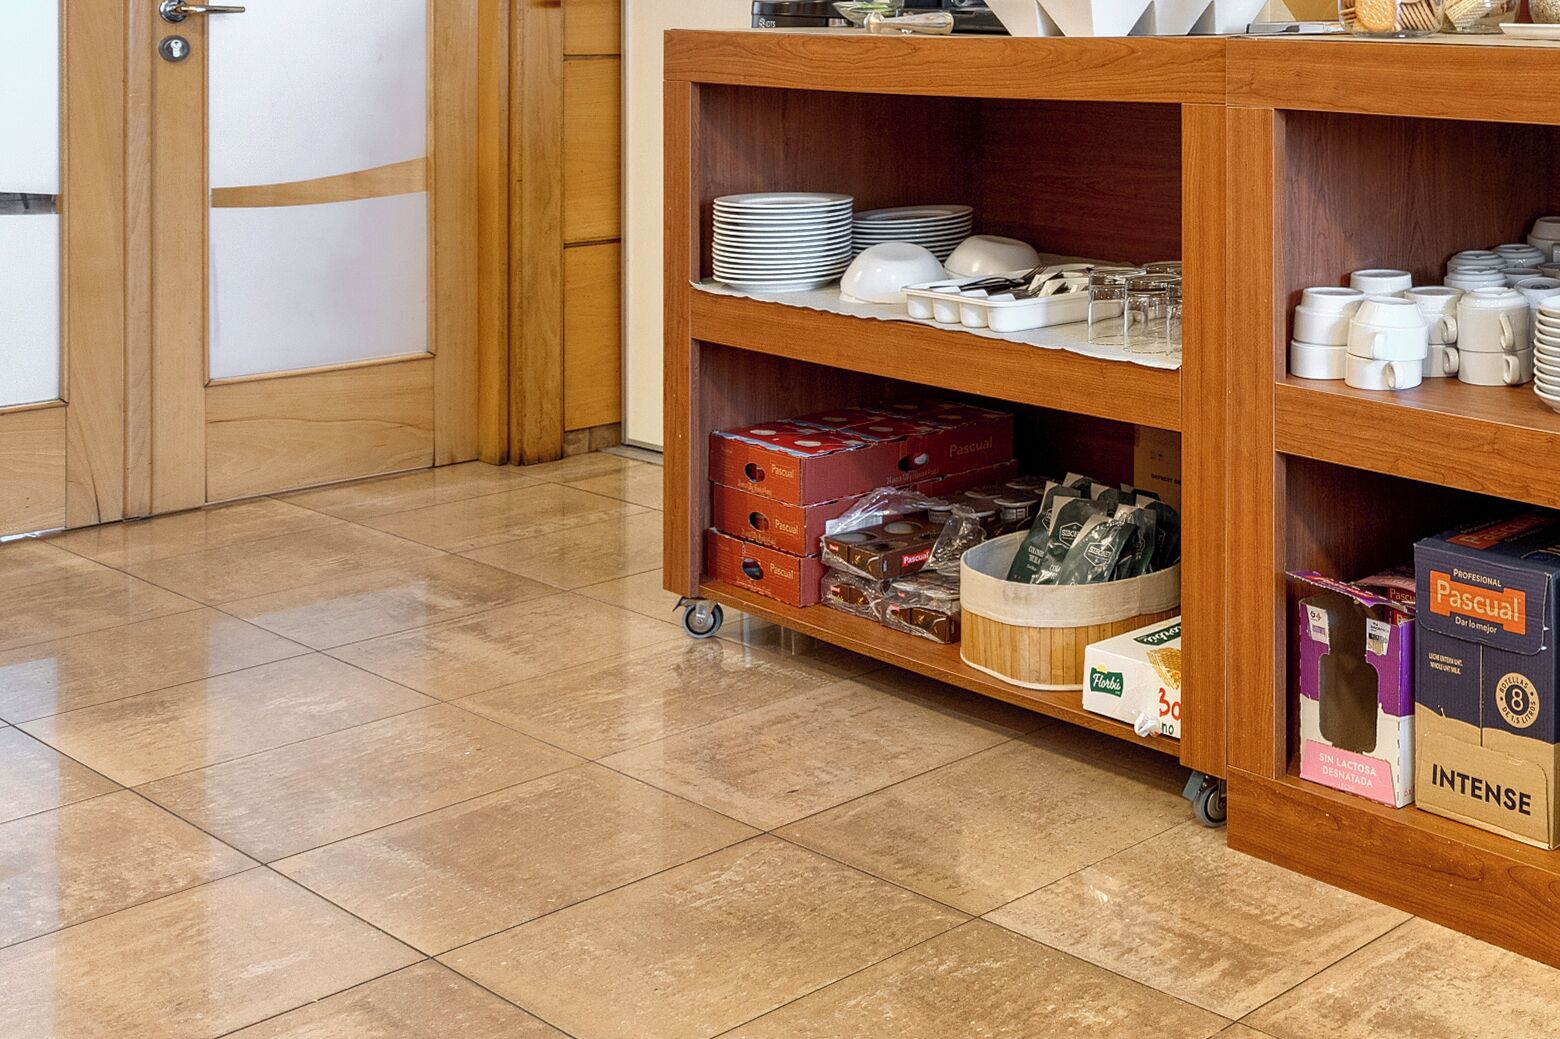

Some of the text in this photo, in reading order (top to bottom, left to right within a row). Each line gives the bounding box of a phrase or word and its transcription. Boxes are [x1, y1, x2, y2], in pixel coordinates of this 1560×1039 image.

[949, 436, 993, 457] Pascual
[771, 463, 795, 479] Pascual
[775, 519, 799, 535] Pascual
[902, 551, 930, 567] Pascual
[769, 563, 795, 580] Pascual
[1453, 568, 1502, 587] PROFESIONAL
[1389, 588, 1416, 601] Pascu
[1437, 579, 1519, 622] Pascual
[1455, 616, 1498, 634] Dar lo mejor
[1092, 673, 1122, 691] Florbú
[1499, 676, 1529, 694] BOTELLAS
[1511, 688, 1524, 712] 8
[1522, 700, 1536, 724] LITROS
[1319, 752, 1377, 776] SIN LACTOSA
[1322, 766, 1373, 788] DESNATADA
[1432, 763, 1532, 817] INTENSE
